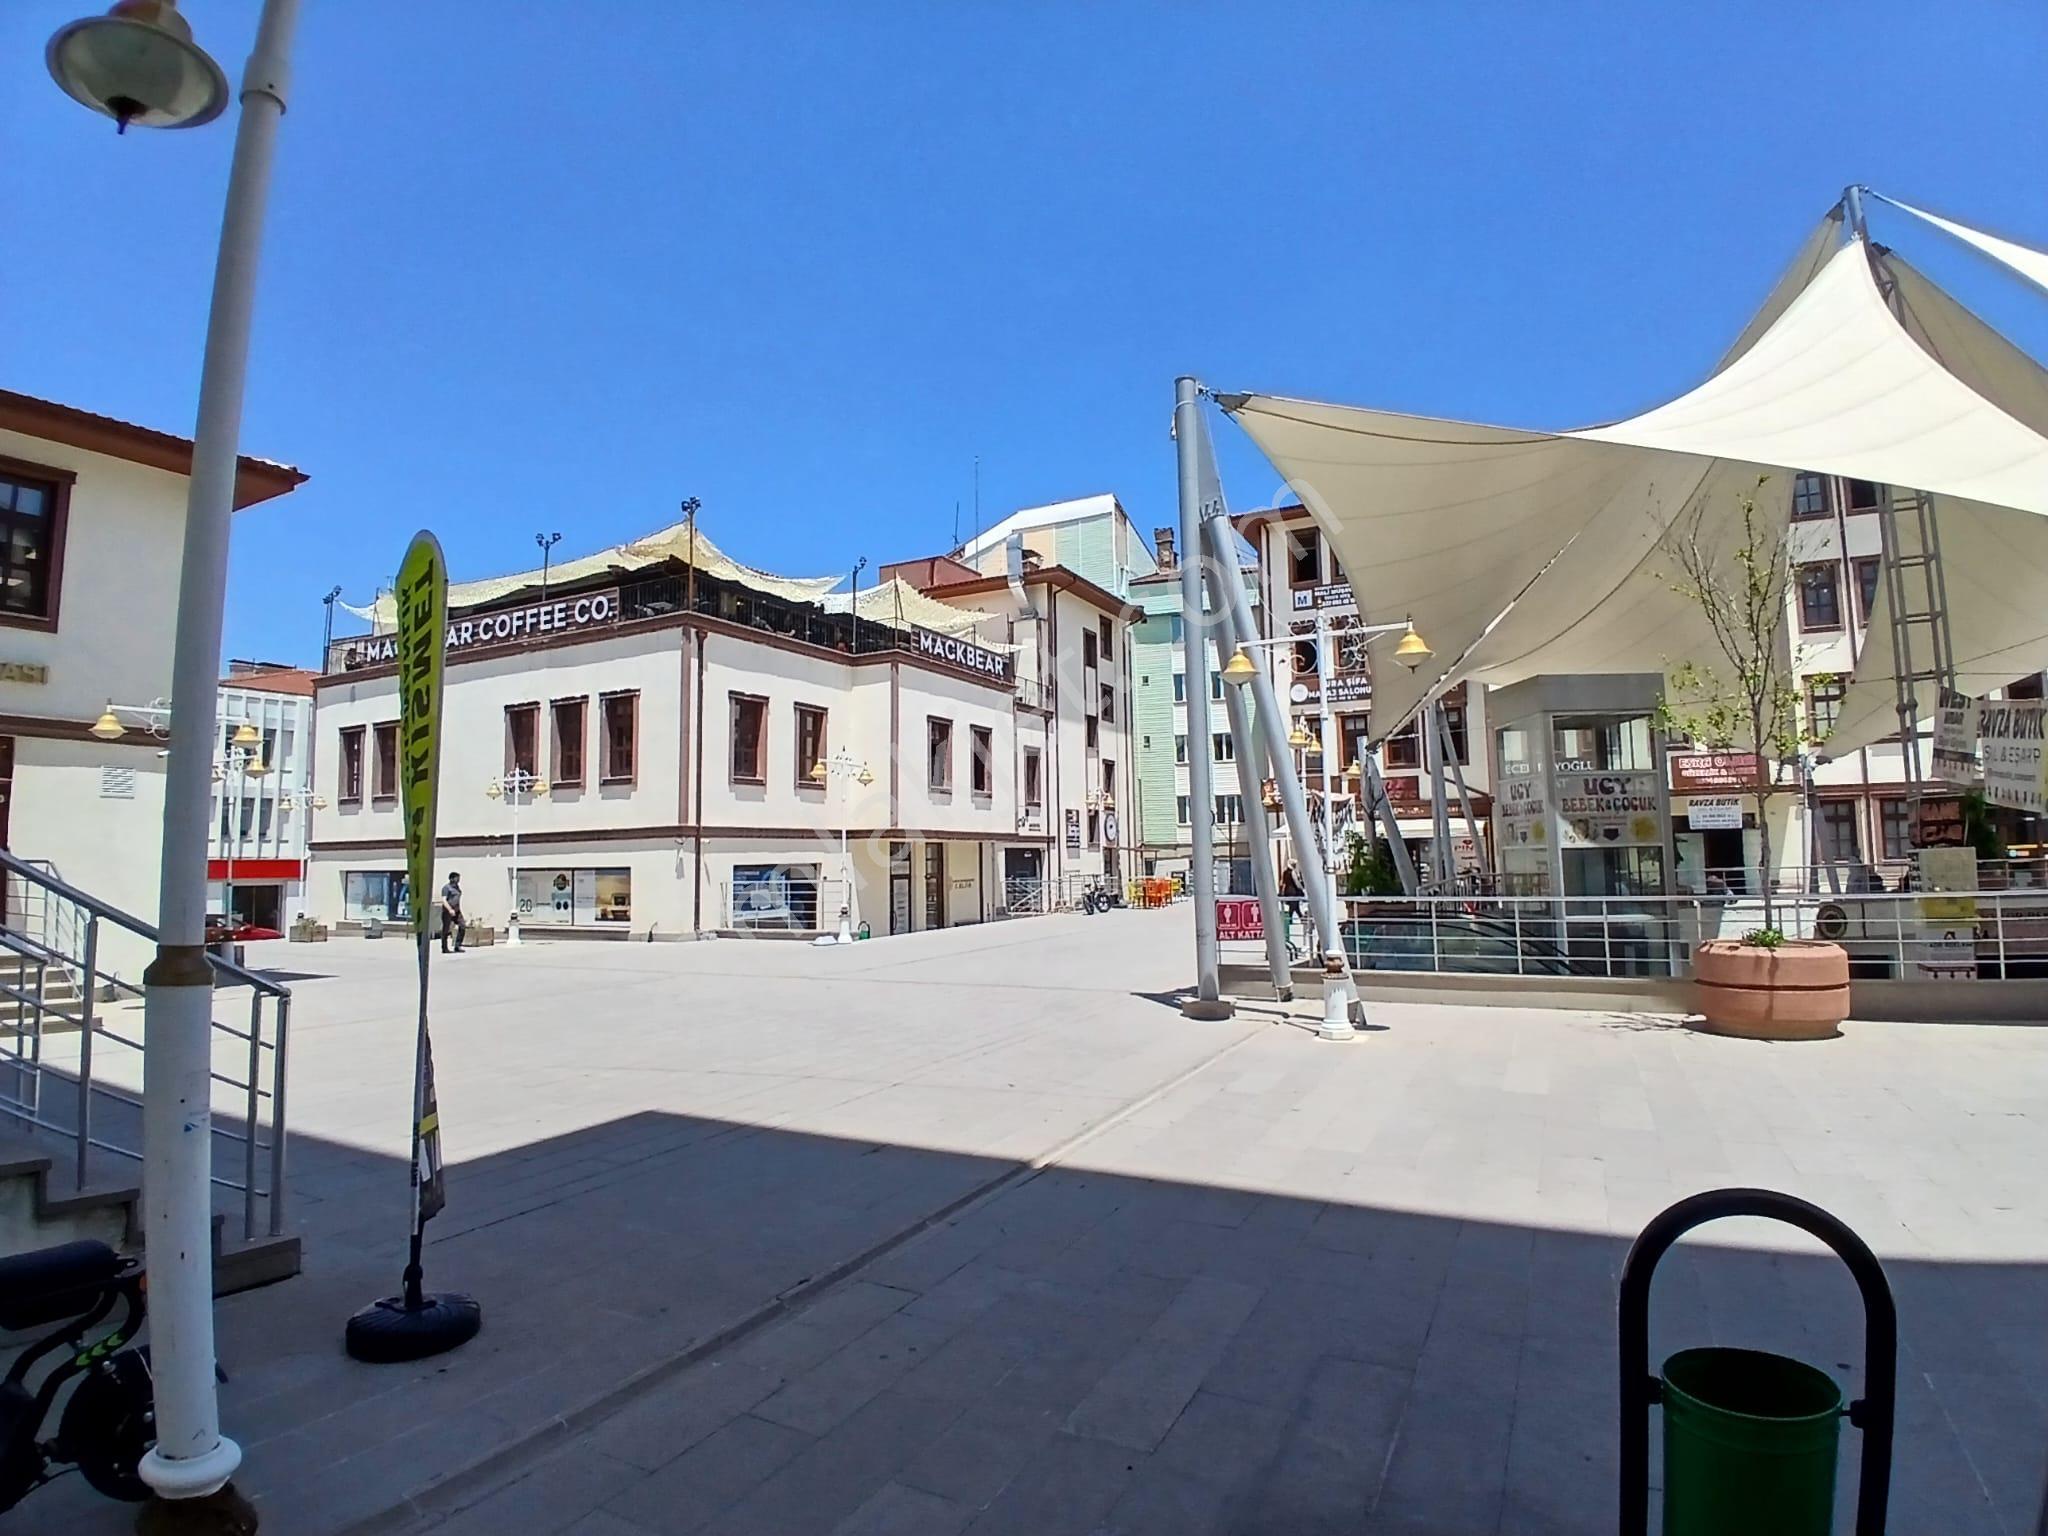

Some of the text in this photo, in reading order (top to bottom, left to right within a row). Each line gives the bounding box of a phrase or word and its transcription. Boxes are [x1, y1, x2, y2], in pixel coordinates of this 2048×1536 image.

[367, 594, 615, 664] MAAR COFFEE CO.
[919, 629, 1004, 676] MACKBEAR
[1308, 688, 1336, 698] MAAJ
[1219, 931, 1235, 939] ALT
